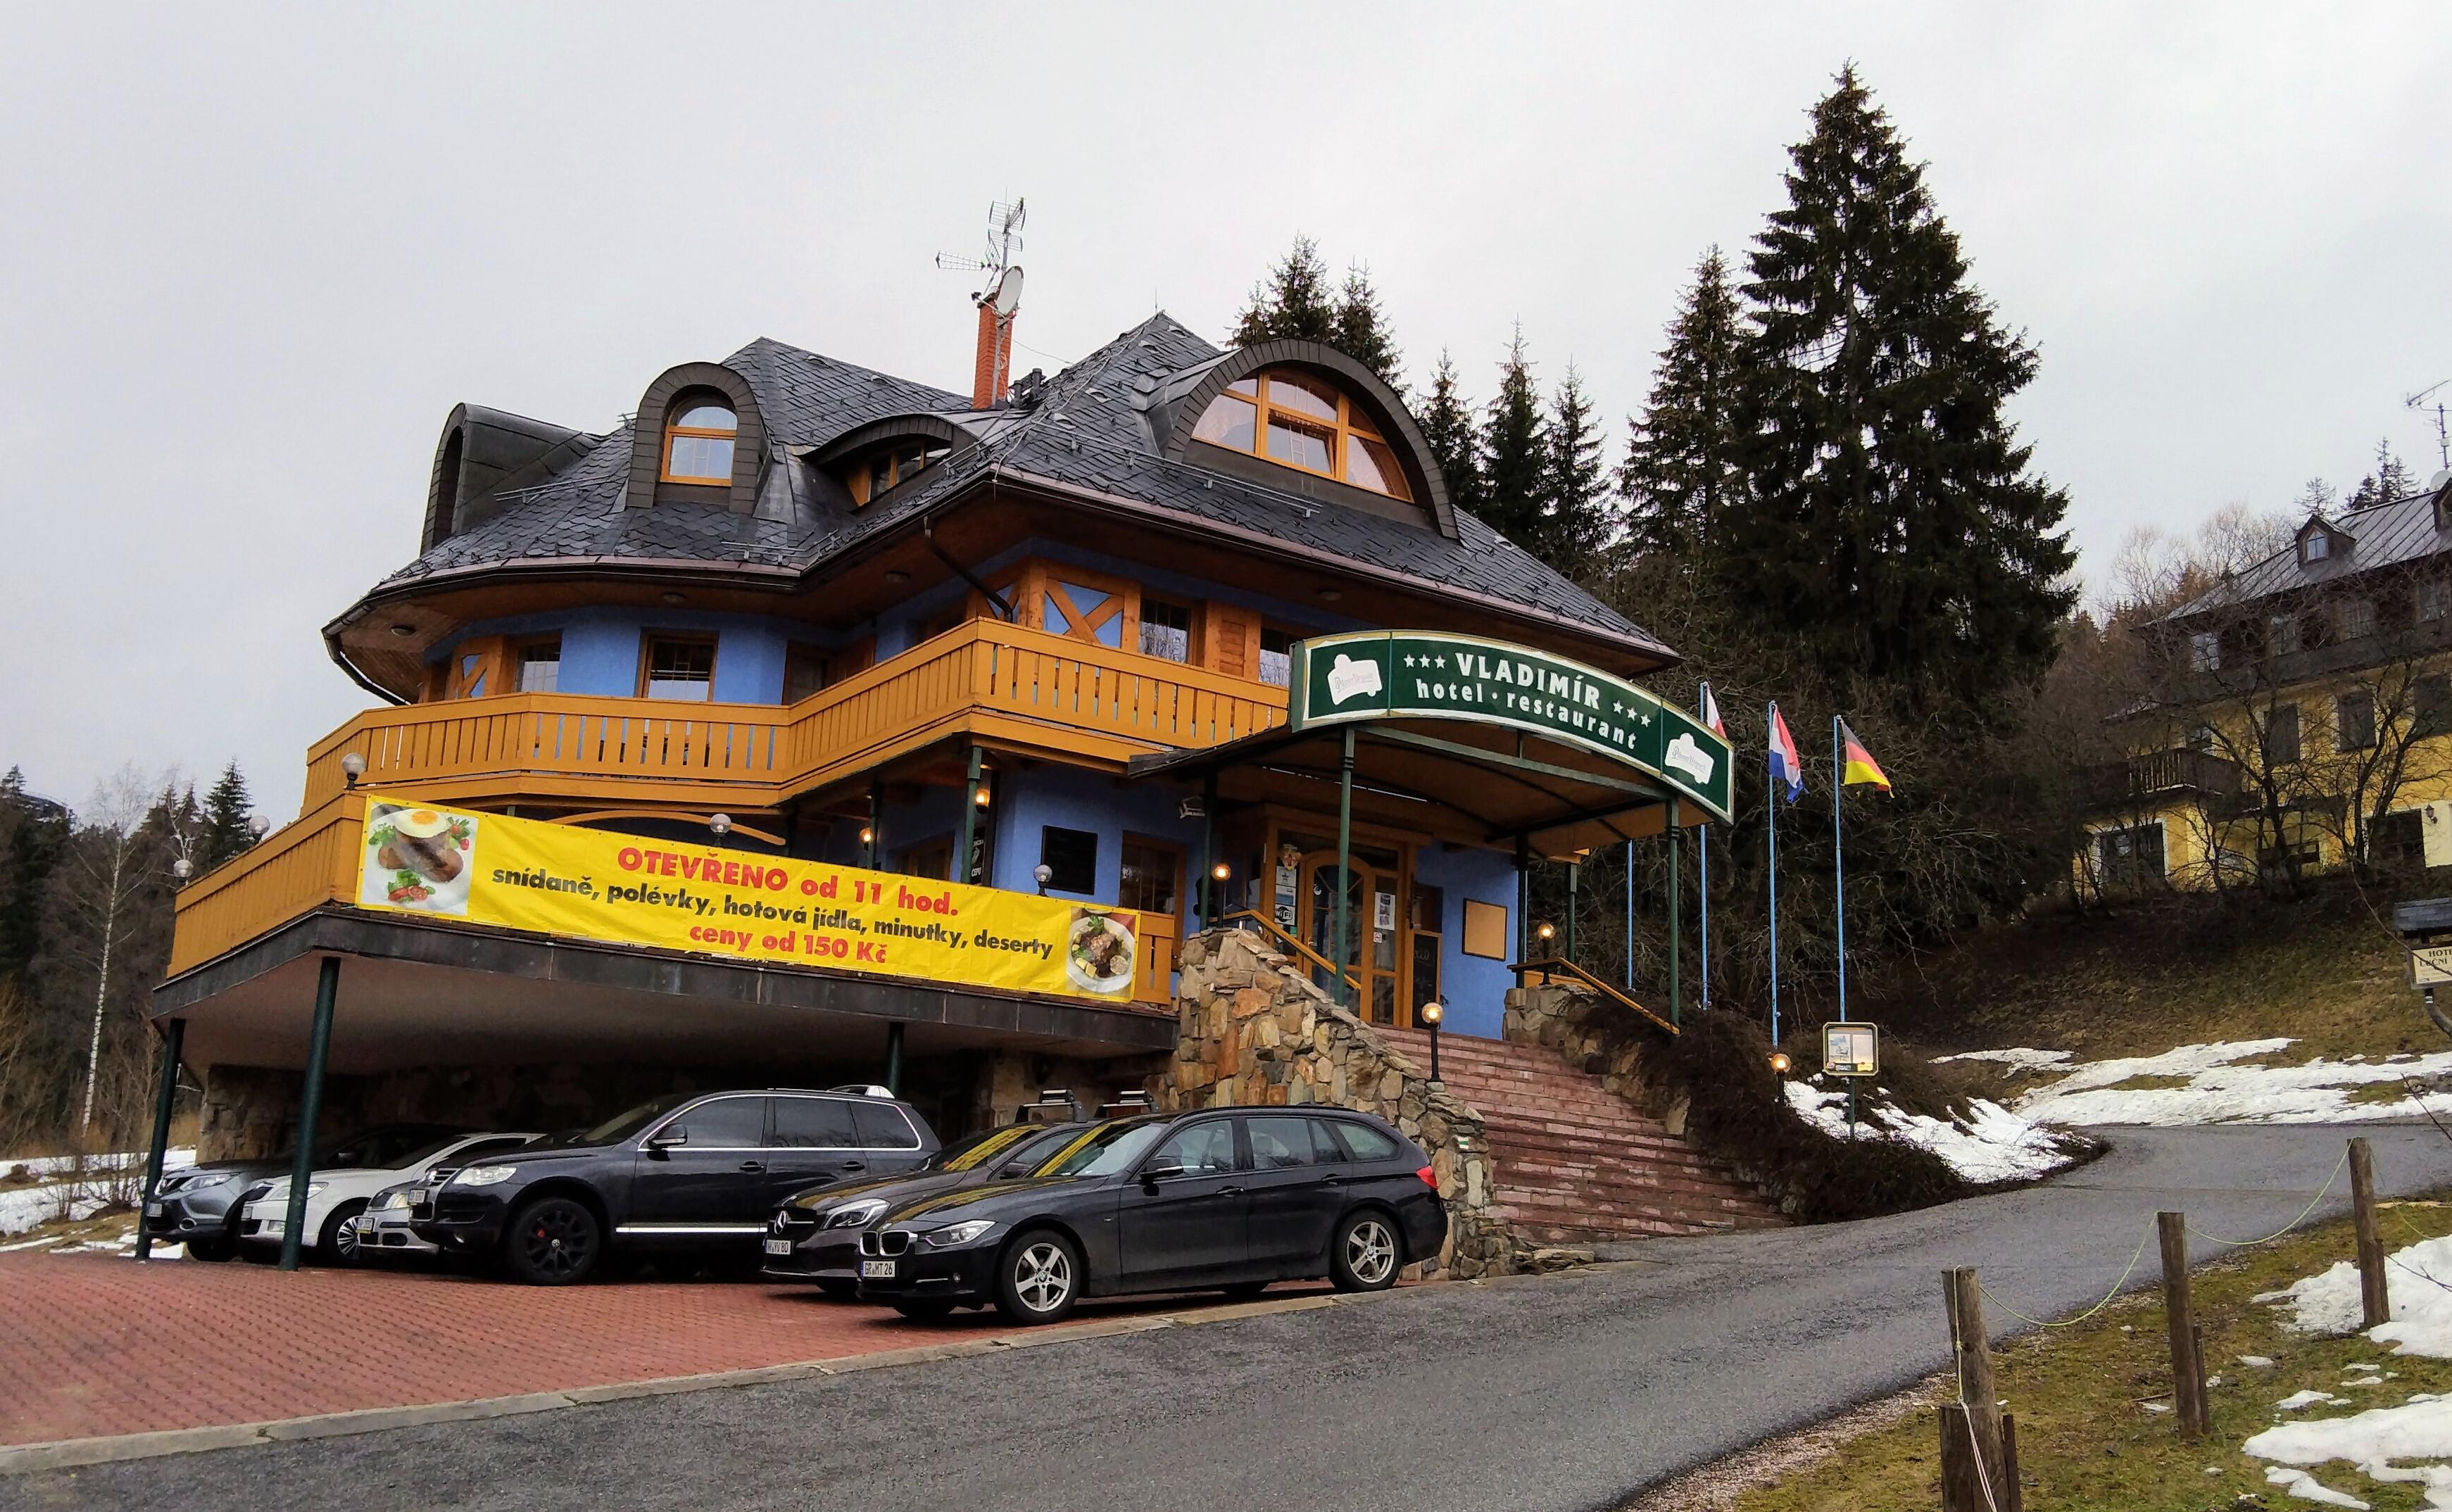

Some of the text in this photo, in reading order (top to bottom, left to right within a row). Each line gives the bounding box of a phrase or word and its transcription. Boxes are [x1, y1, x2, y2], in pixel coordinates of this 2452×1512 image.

[1416, 679, 1636, 750] hotel restaurant
[1454, 653, 1600, 710] VLADIMÍR
[492, 868, 1053, 959] snídaně, polévky, hotová jídla, minutky, deserty
[618, 848, 958, 916] OTEVŘENO od 11 hod.
[689, 926, 886, 964] ceny od 150 Kč
